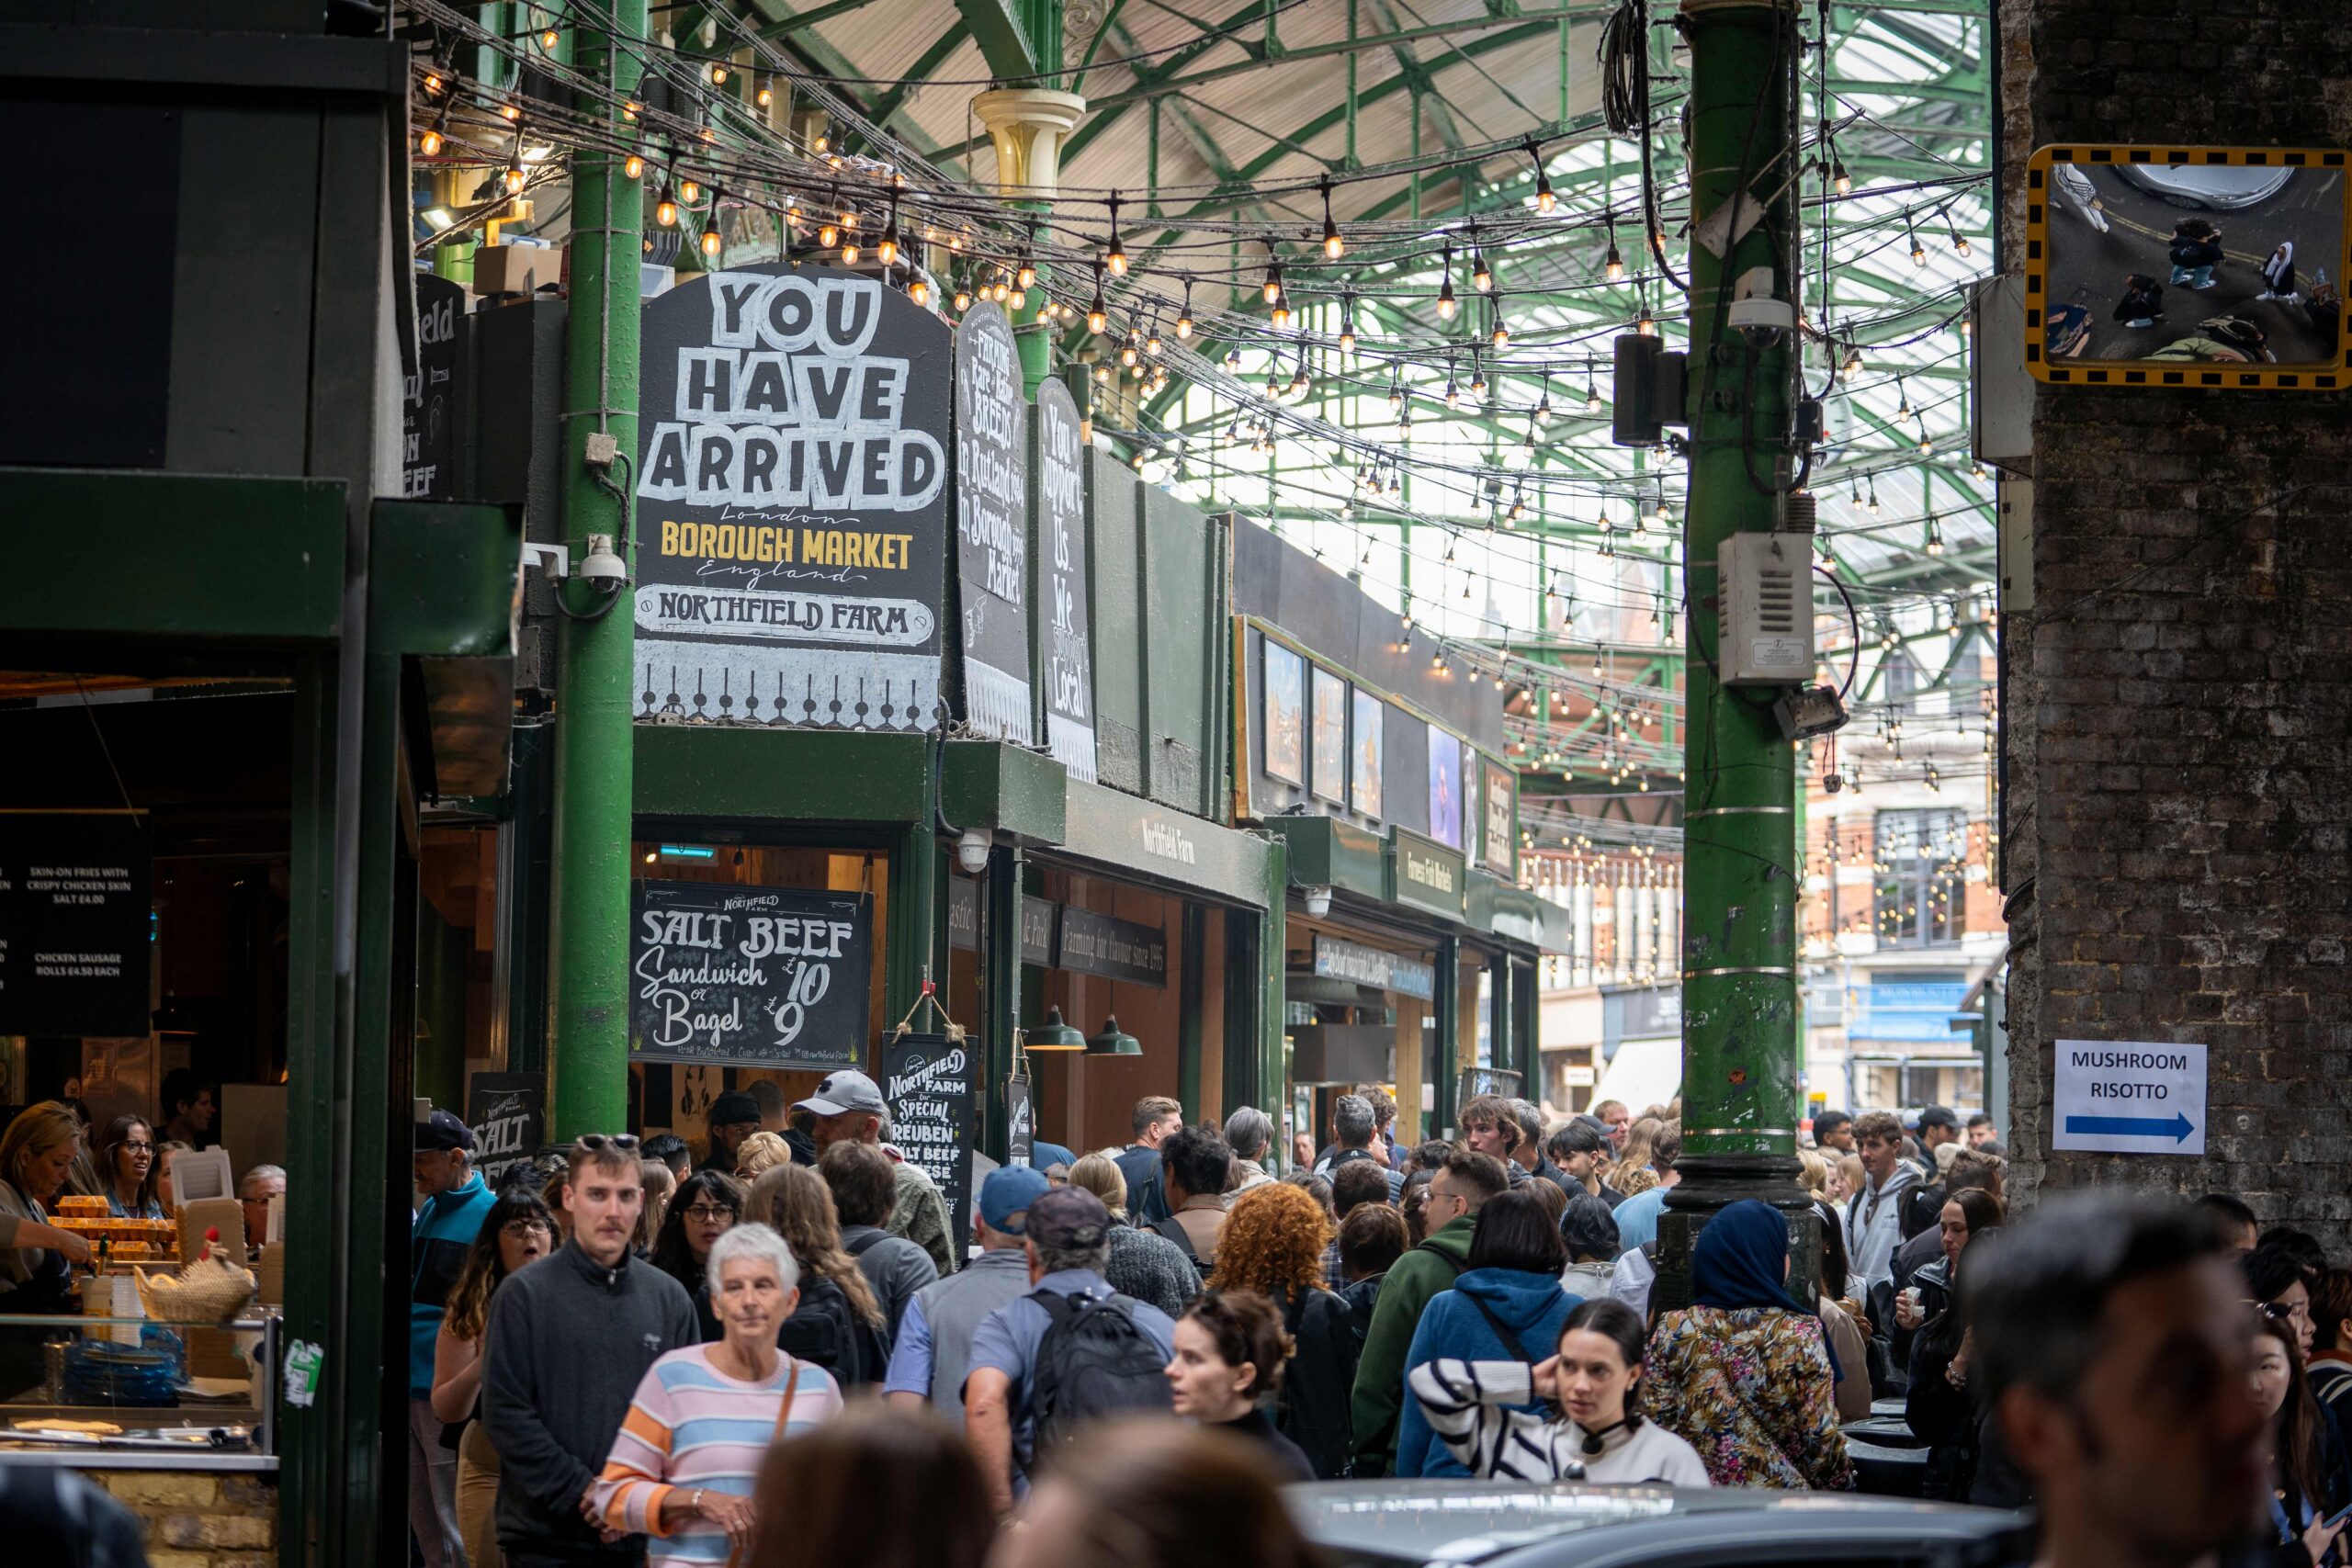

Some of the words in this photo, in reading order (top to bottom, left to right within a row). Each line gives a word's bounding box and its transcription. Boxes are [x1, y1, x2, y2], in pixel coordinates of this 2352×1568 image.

[709, 272, 882, 359] YOU
[972, 355, 990, 393] Rare
[978, 329, 1010, 377] FARMING
[675, 346, 910, 429] HAVE
[973, 390, 1012, 450] BREEDS
[1049, 404, 1071, 465] You
[637, 422, 945, 512] ARRIVED
[957, 429, 970, 487] In
[971, 439, 1011, 509] Rutland
[720, 506, 861, 525] London
[958, 486, 970, 544] In
[971, 494, 1012, 567] Borough
[661, 520, 795, 563] BOROUGH
[802, 529, 914, 570] MARKET
[696, 559, 868, 591] England
[987, 547, 1021, 605] Market
[659, 592, 824, 632] NORTHFIELD
[831, 603, 910, 637] FARM
[1053, 656, 1085, 719] Local
[27, 881, 61, 891] CRISPY
[62, 881, 106, 891] CHICKEN
[107, 882, 131, 891] SKIN
[29, 867, 73, 877] SKIN-ON
[74, 867, 101, 877] FRIES
[102, 868, 129, 877] WITH
[53, 894, 77, 904] SALT
[723, 895, 779, 911] NORTHFIELD
[640, 910, 732, 950] SALT
[739, 917, 854, 959] BEEF
[1063, 921, 1095, 967] Farming
[1096, 926, 1107, 959] for
[1108, 929, 1131, 964] flavour
[35, 953, 76, 963] CHICKEN
[78, 953, 121, 964] SAUSAGE
[36, 965, 67, 976] ROLLS
[94, 966, 120, 976] EACH
[635, 945, 768, 999] Sandwich
[781, 956, 831, 1007] £10
[690, 986, 708, 1001] or
[652, 988, 743, 1048] Bagel
[763, 996, 805, 1046] £9
[888, 1048, 966, 1101] NORTHFIELD
[2072, 1052, 2187, 1070] MUSHROOM
[487, 1093, 519, 1121] NORTHFIELD
[925, 1079, 967, 1094] FARM
[2090, 1082, 2168, 1100] RISOTTO
[892, 1123, 954, 1144] REUBEN
[899, 1099, 949, 1123] SPECIAL
[472, 1113, 530, 1158] SALT
[900, 1146, 921, 1160] ALT
[922, 1147, 961, 1162] BEEF
